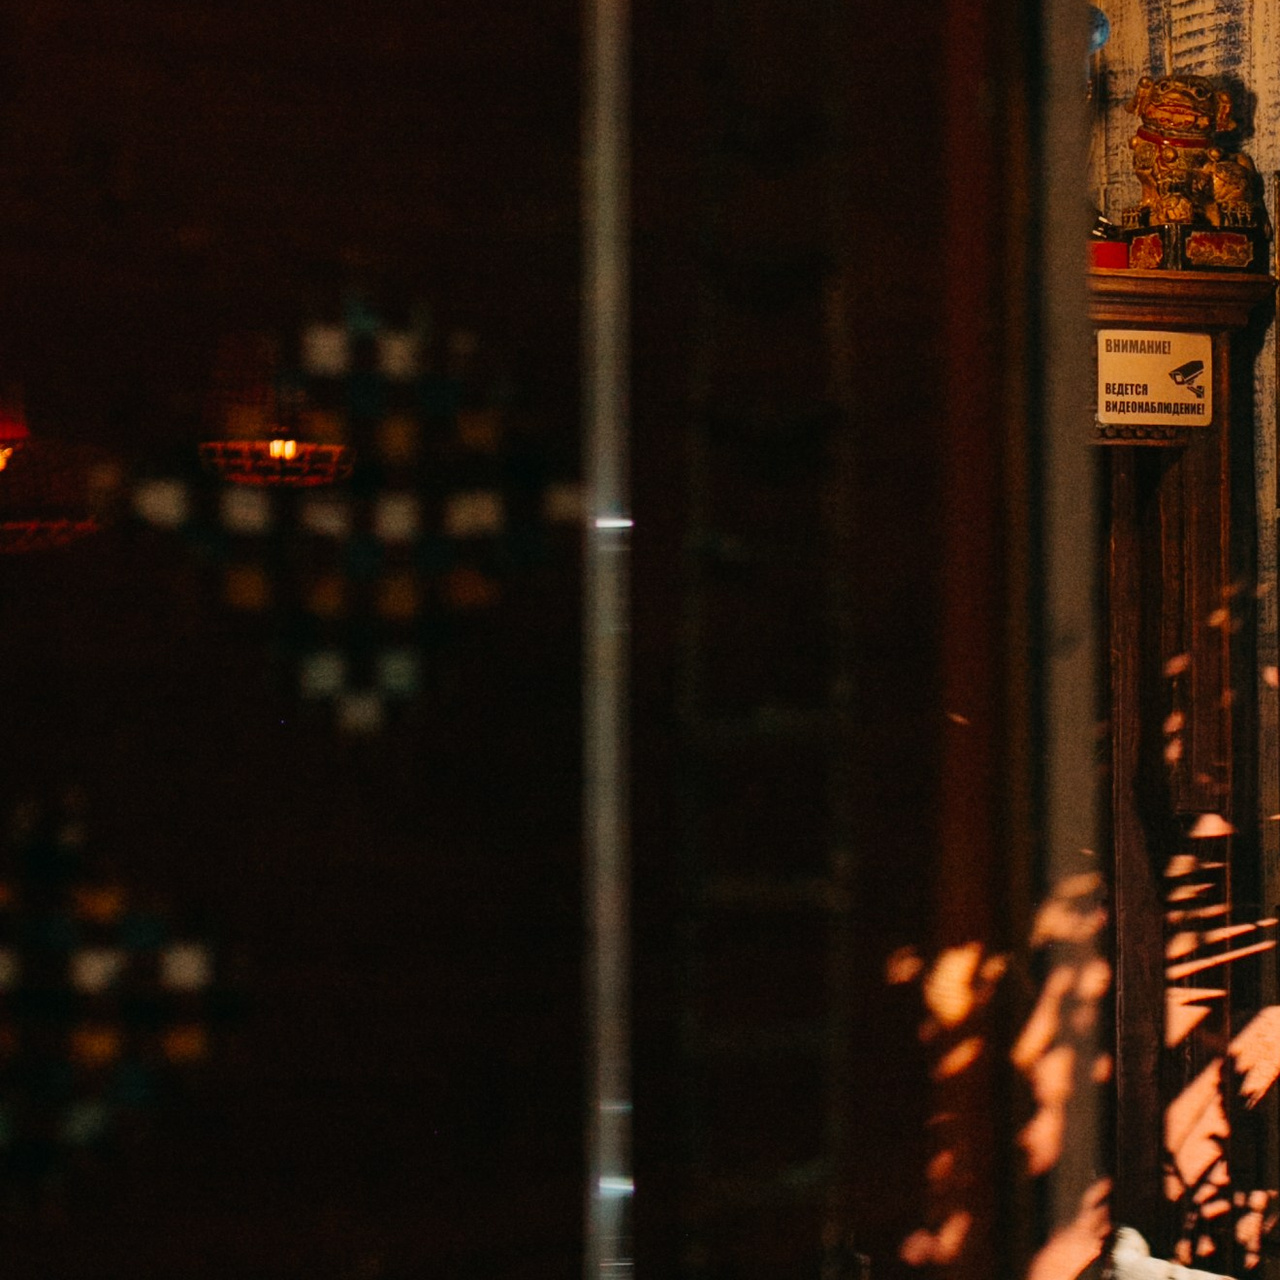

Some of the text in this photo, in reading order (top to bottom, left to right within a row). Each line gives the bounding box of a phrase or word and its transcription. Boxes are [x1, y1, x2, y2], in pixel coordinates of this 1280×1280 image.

[1105, 338, 1171, 355] ВНИМАНИЕ!
[1105, 383, 1148, 396] ВЕДЕТСЯ
[1105, 401, 1205, 416] ВИДЕОНАБЛЮДЕНИЕ!
